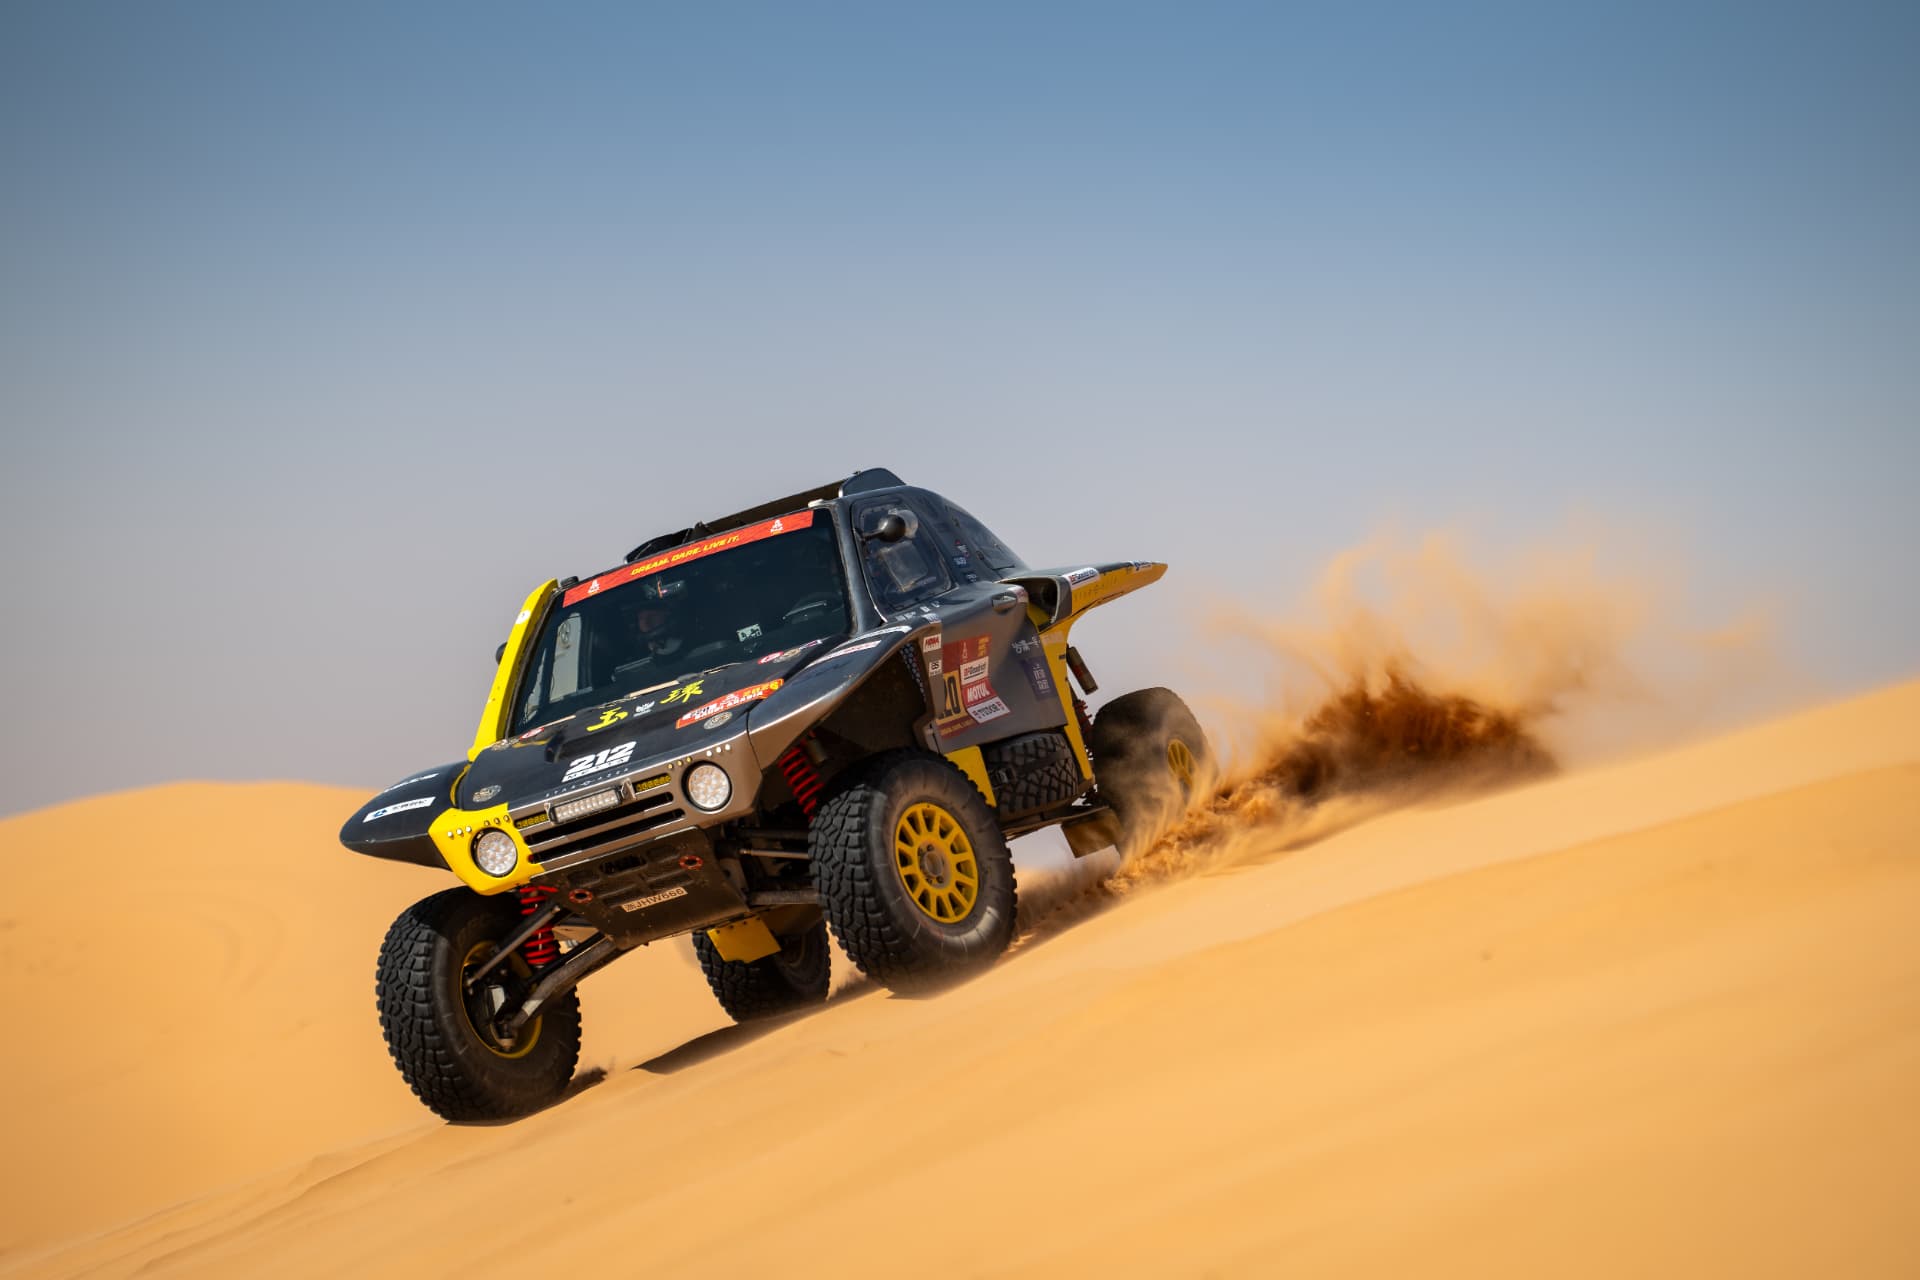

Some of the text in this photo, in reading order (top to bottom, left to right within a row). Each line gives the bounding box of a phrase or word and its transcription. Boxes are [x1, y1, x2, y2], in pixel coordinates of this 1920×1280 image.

[630, 558, 669, 576] DREAM.
[671, 548, 701, 562] DARE.
[703, 538, 726, 553] LIVE
[967, 683, 990, 703] MOTUL
[565, 741, 637, 776] 212
